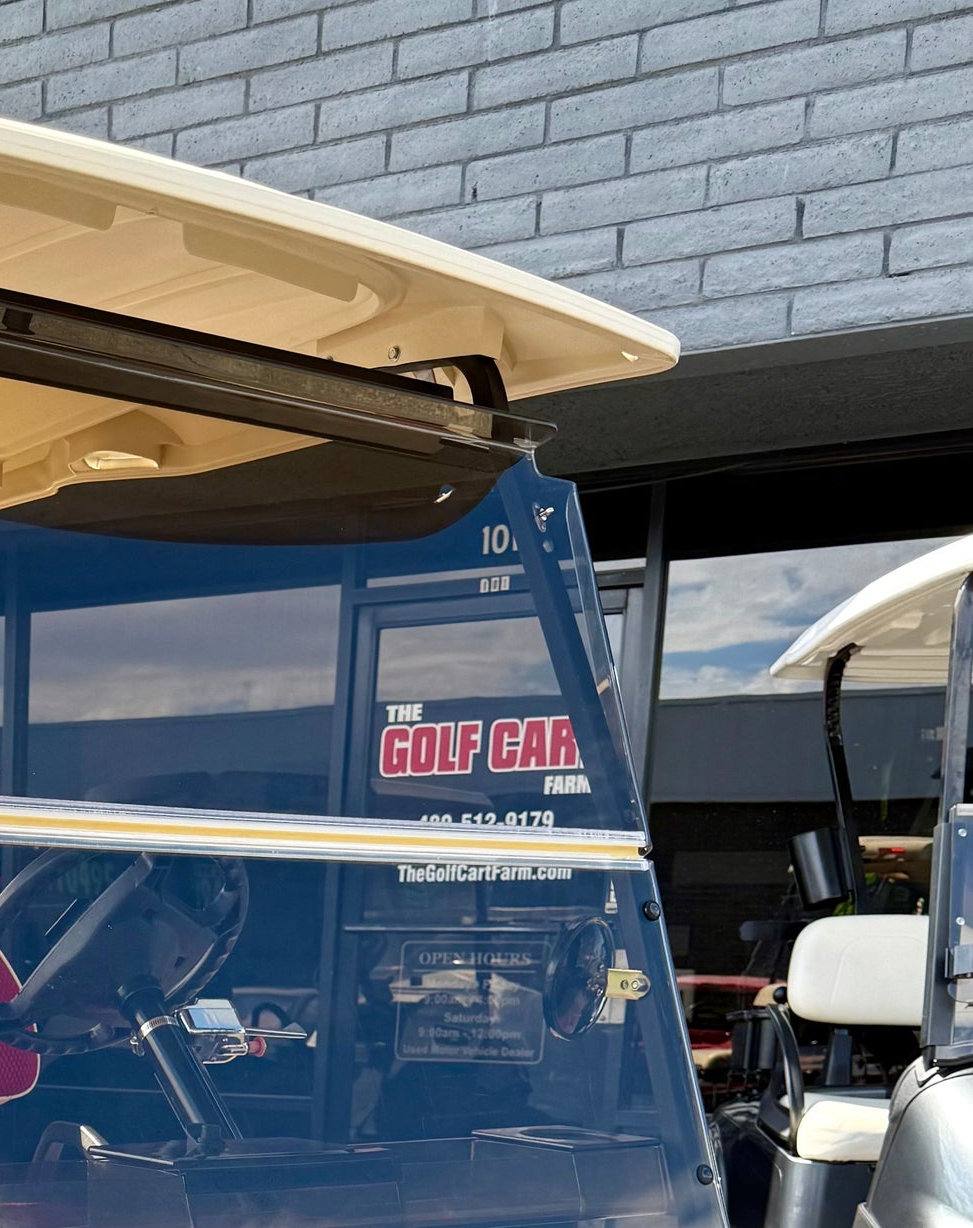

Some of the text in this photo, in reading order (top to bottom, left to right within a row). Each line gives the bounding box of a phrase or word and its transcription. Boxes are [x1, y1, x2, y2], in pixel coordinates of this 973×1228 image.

[386, 703, 424, 723] THE
[379, 715, 584, 778] GOLF CAR
[543, 774, 592, 795] FARM
[420, 810, 555, 828] 512-9179
[397, 864, 573, 884] TheGolfCartFarm.com
[418, 951, 533, 966] OPEN HOURS
[443, 1012, 501, 1025] Saturday
